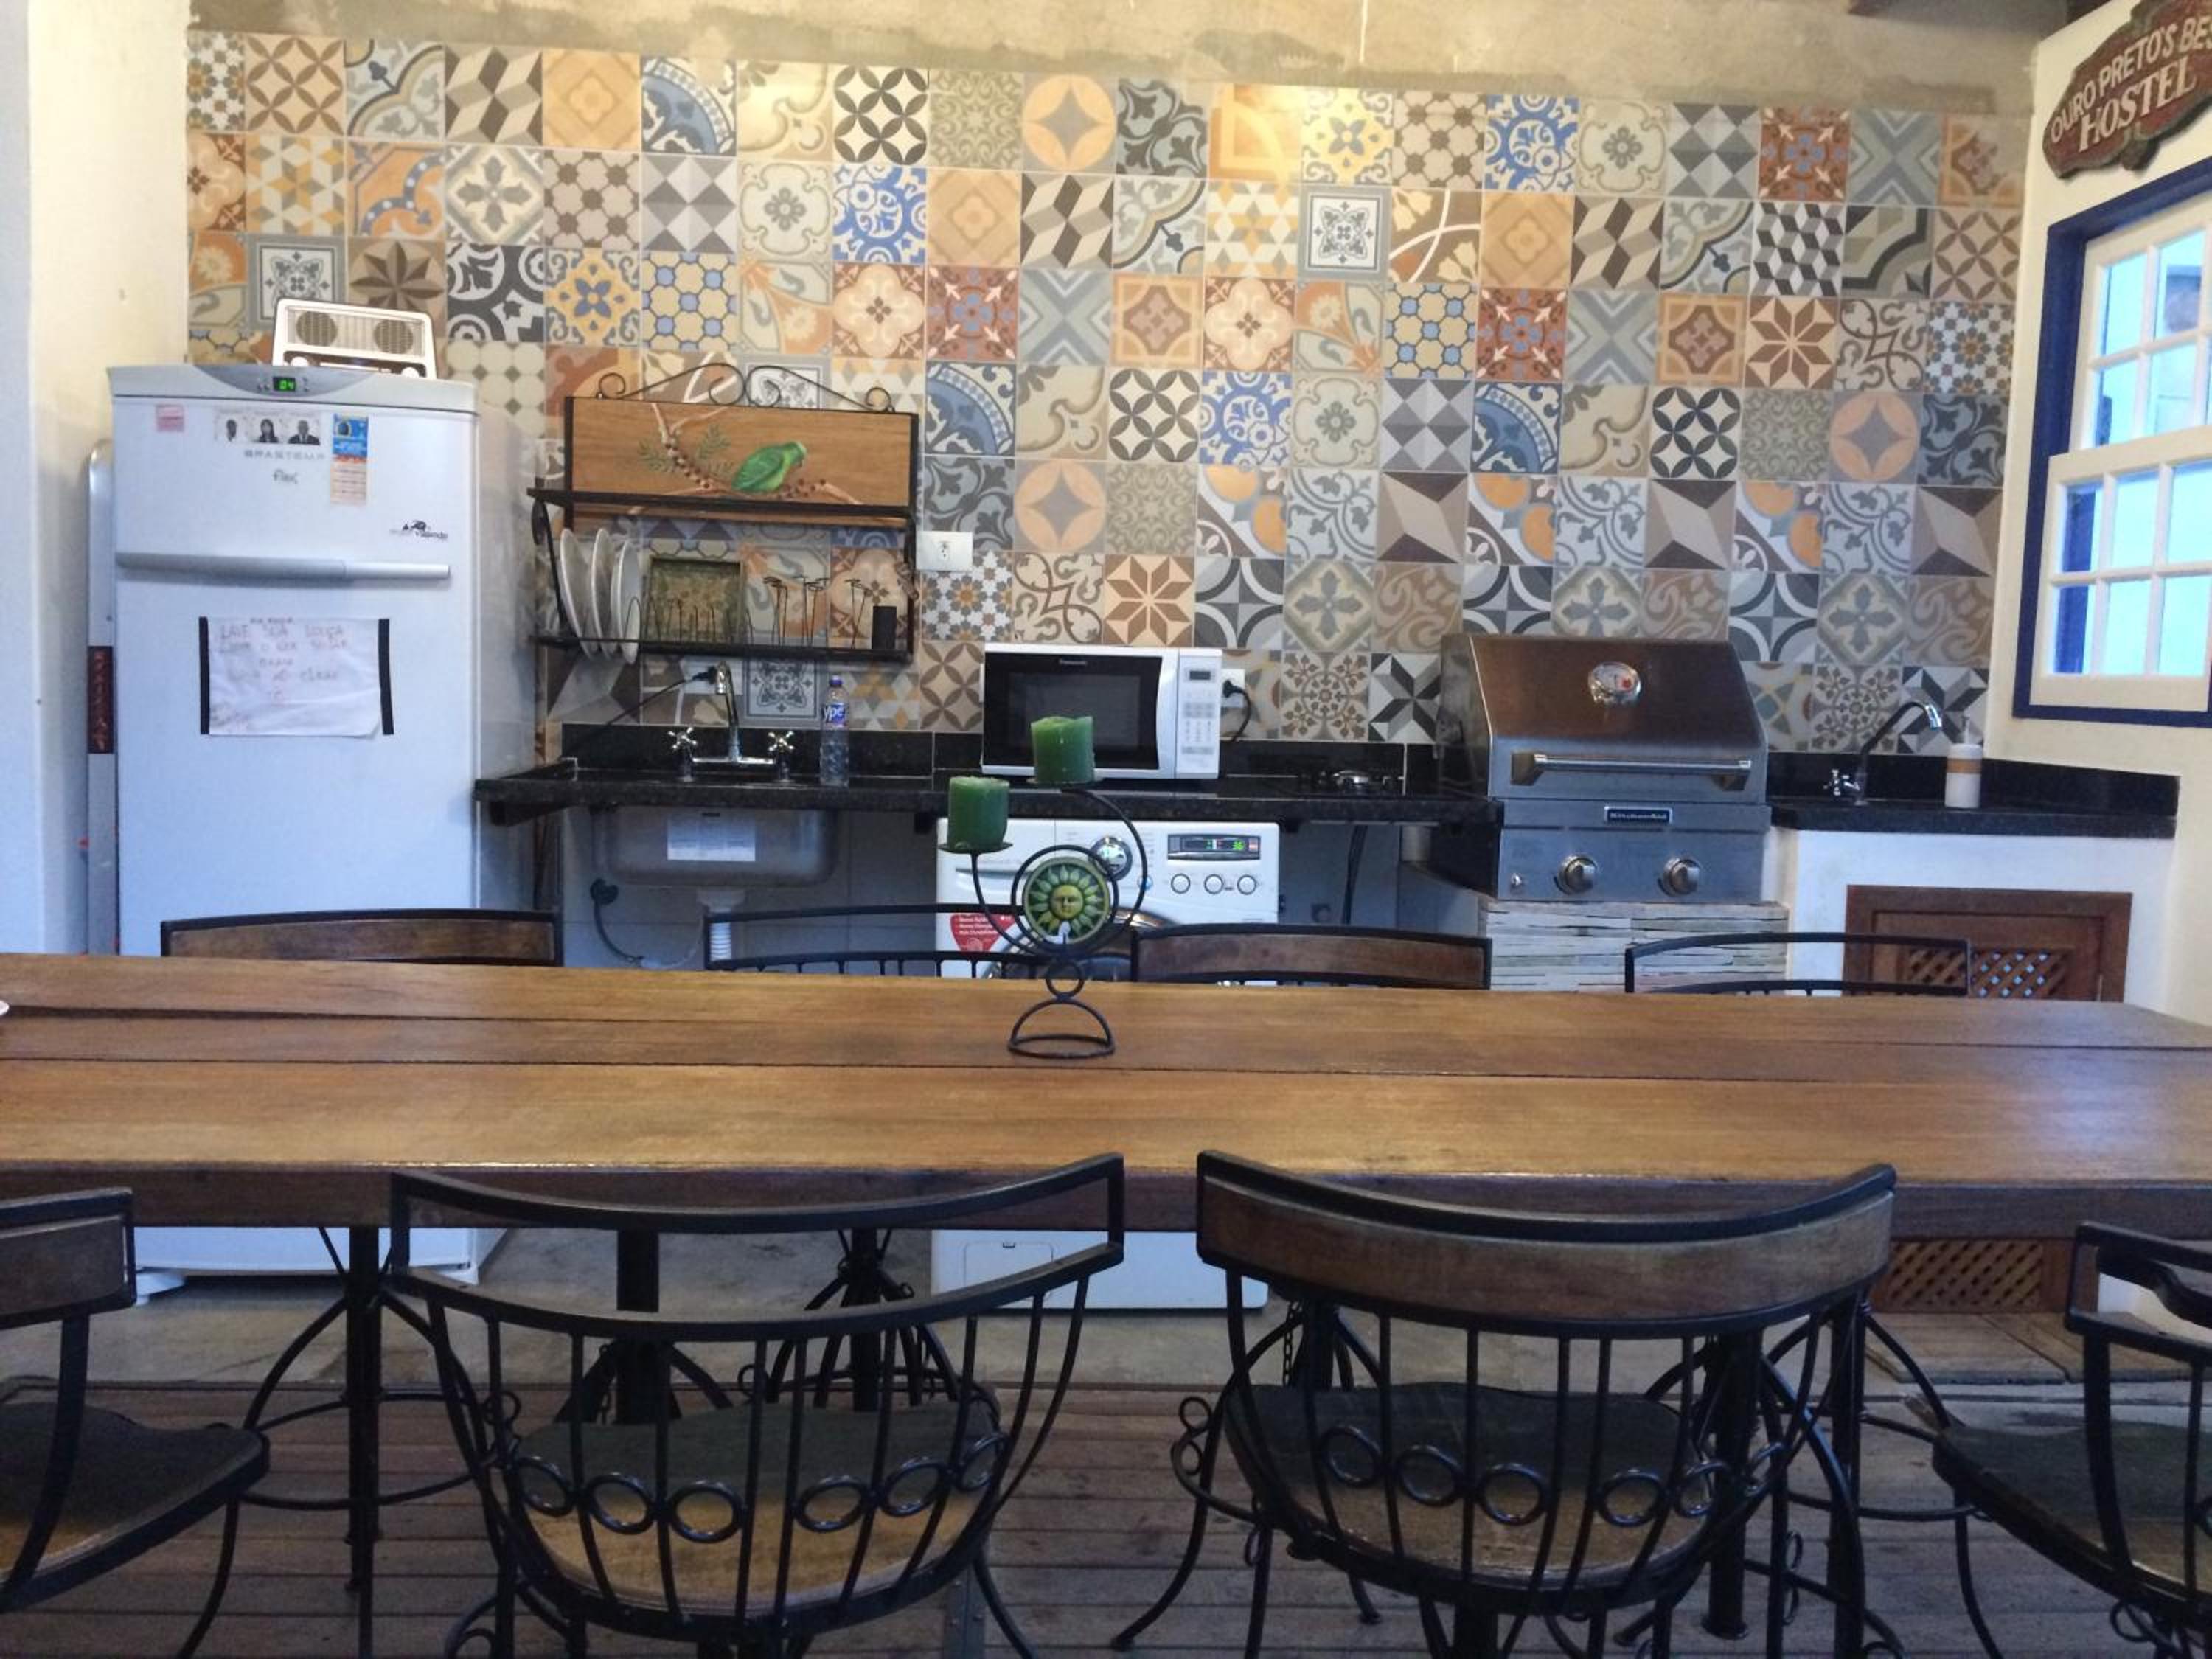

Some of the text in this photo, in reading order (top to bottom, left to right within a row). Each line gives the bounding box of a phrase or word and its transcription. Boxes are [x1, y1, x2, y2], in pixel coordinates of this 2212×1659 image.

[2051, 80, 2096, 143] OURO
[2099, 23, 2178, 98] PRETO'S
[2079, 55, 2197, 153] HOSTEL
